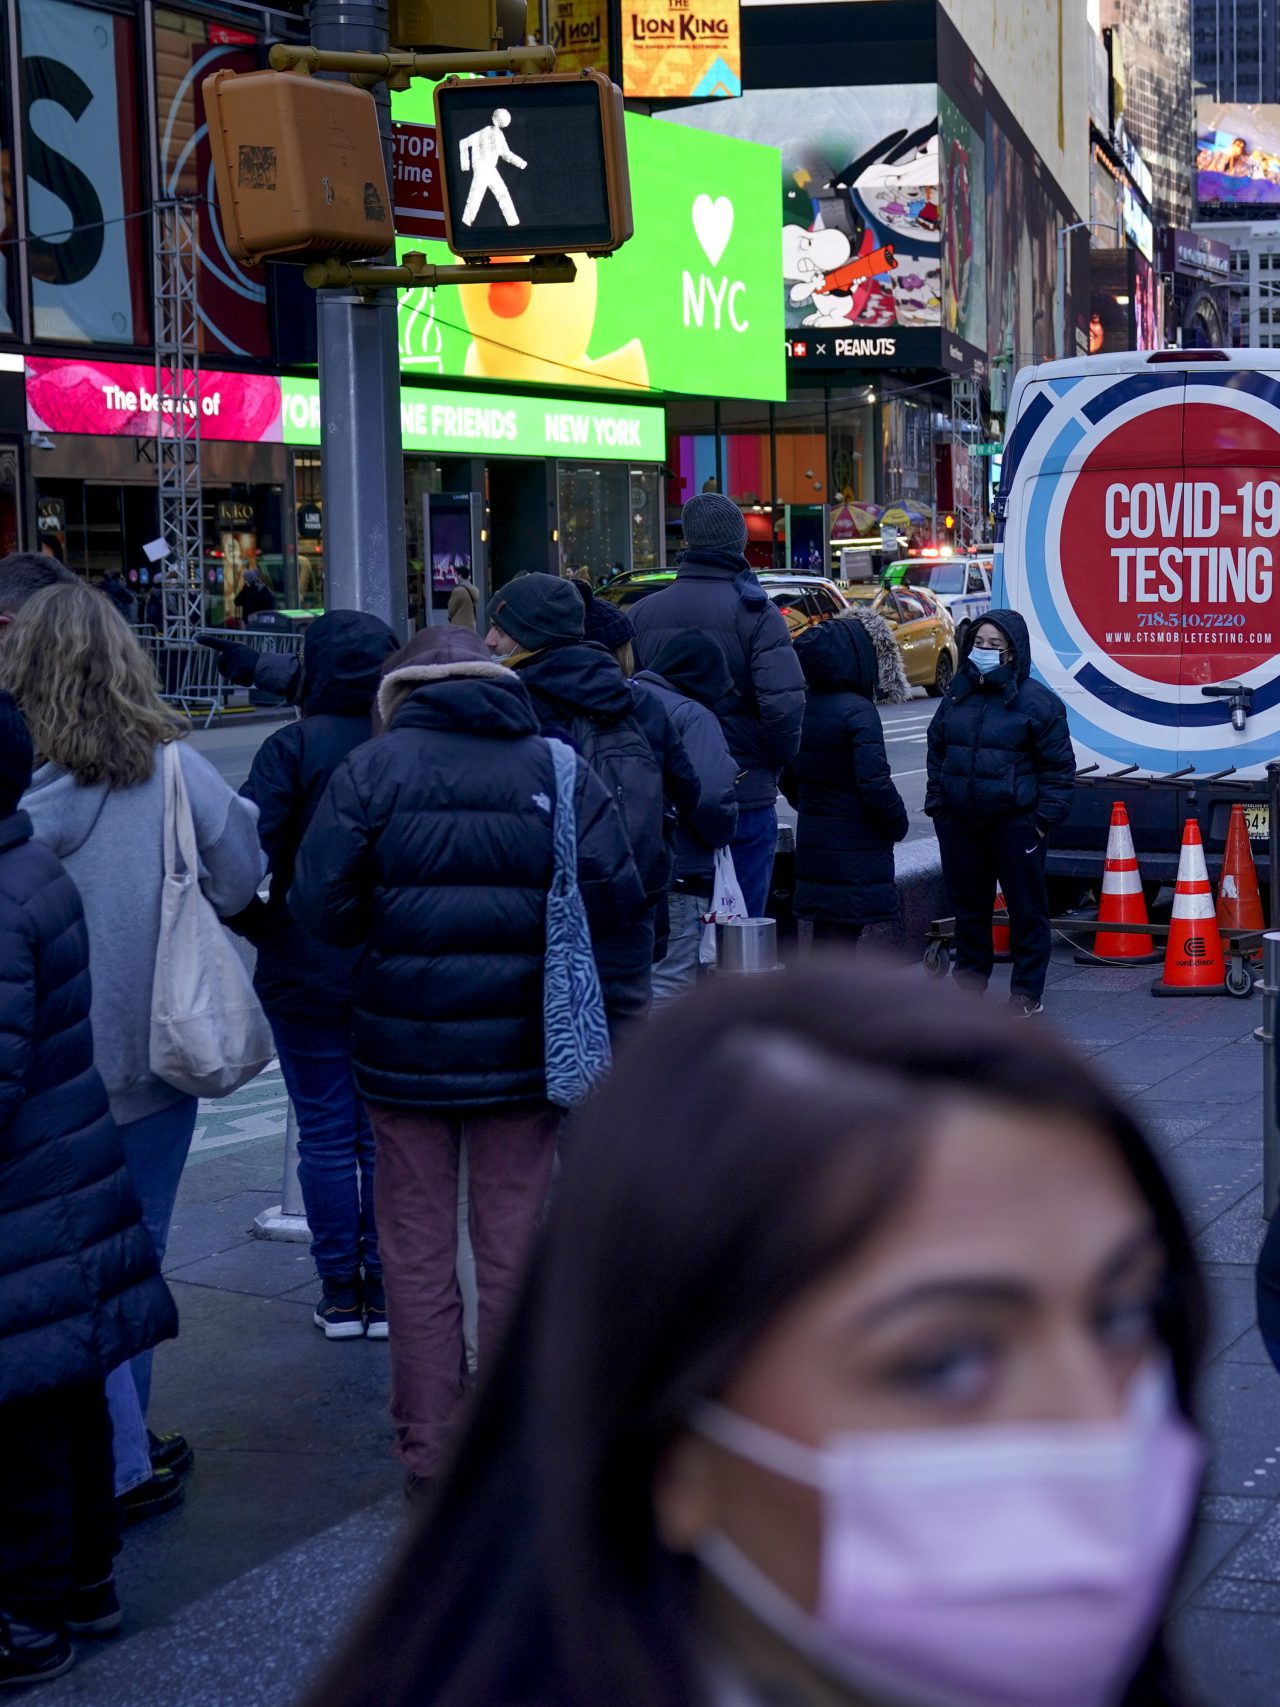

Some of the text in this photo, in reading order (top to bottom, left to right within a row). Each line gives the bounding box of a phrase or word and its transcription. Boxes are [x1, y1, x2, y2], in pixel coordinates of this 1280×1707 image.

[668, 0, 689, 8] THE
[632, 14, 729, 41] LION KING
[392, 135, 439, 159] TOP
[682, 269, 749, 333] NYC
[835, 338, 896, 357] PEANUTS
[102, 385, 137, 412] The
[202, 392, 220, 415] of
[432, 404, 518, 441] FRIENDS
[544, 412, 642, 448] NEW YORK
[1110, 546, 1274, 604] TESTING
[1137, 611, 1246, 628] 718.540.7220
